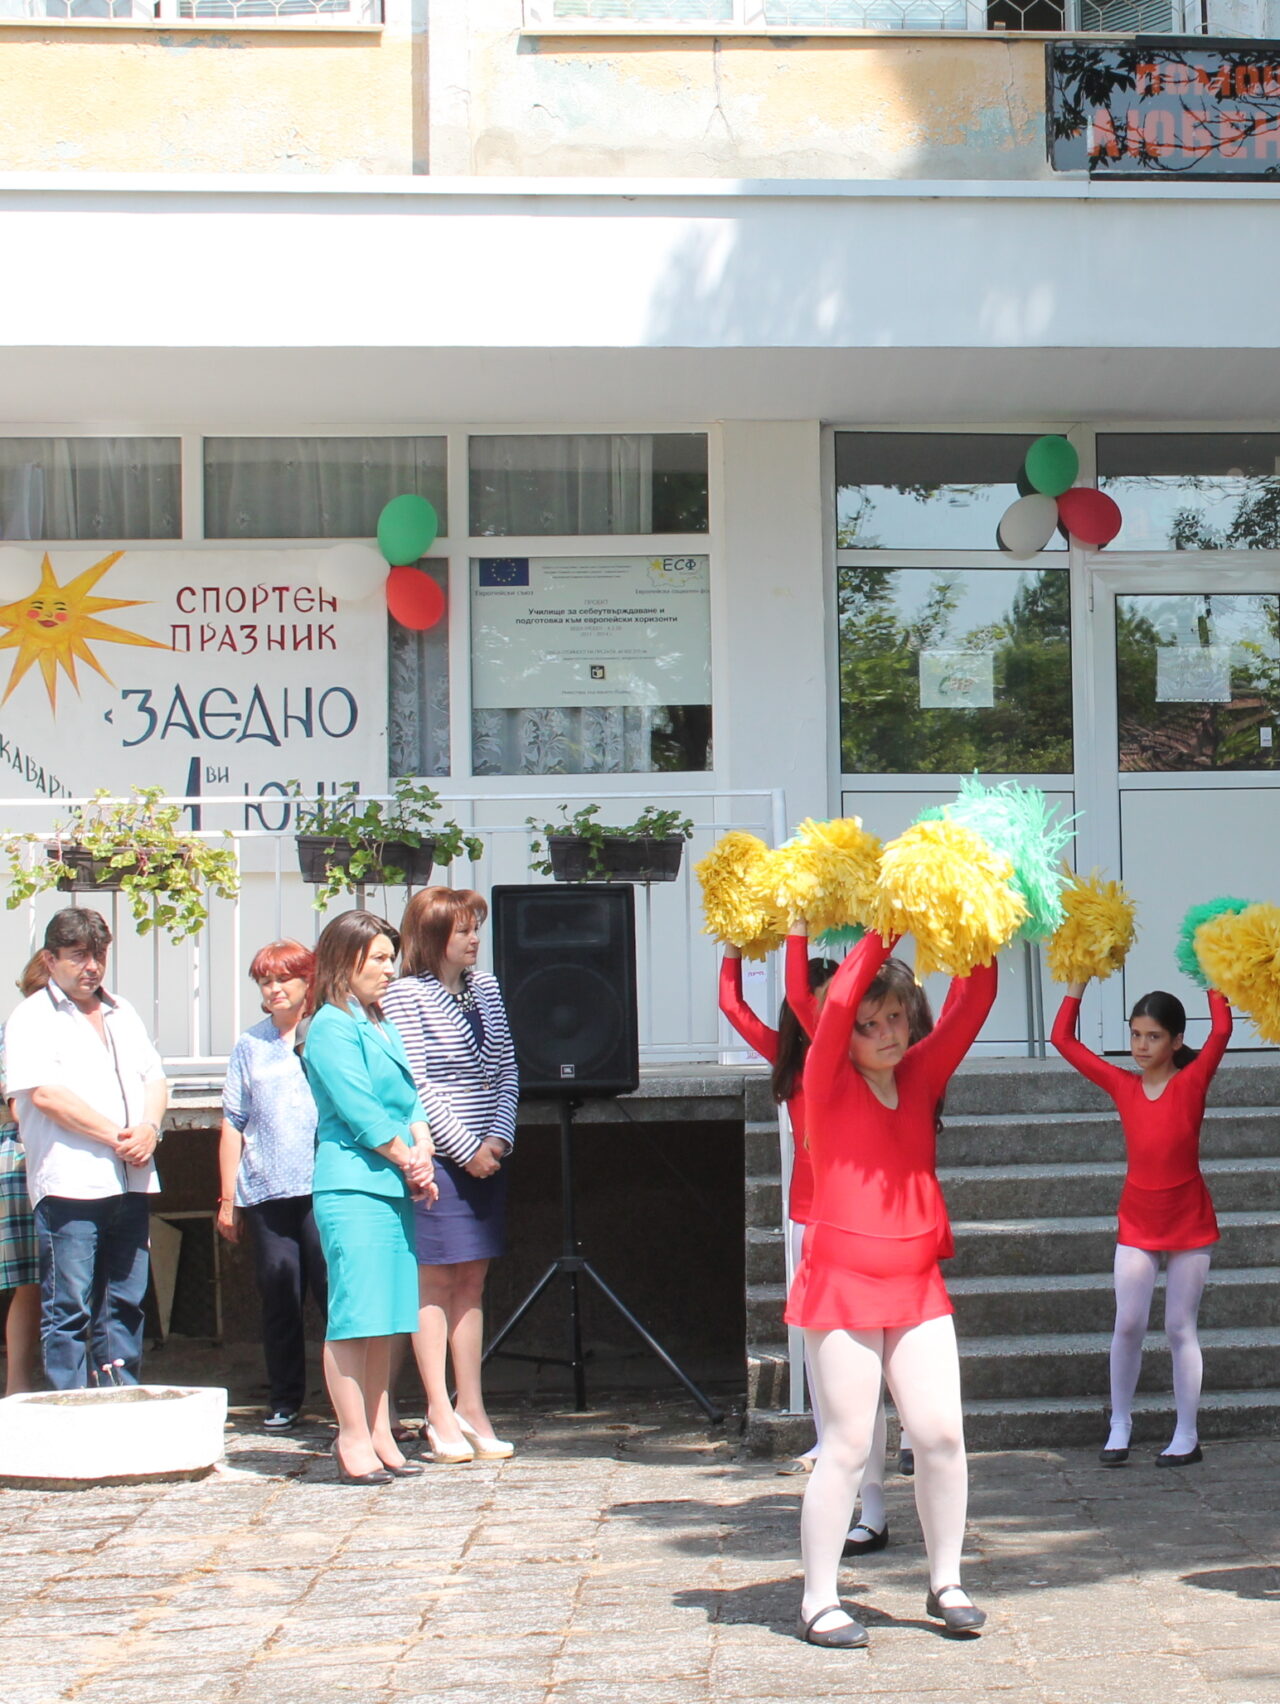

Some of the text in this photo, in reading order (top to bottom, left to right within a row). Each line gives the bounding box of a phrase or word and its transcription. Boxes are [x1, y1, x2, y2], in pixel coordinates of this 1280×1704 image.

[663, 558, 696, 571] ЕСФ
[176, 583, 338, 614] СПОРТЕН
[583, 616, 633, 624] европейски
[170, 623, 337, 655] ПРАЗНИК
